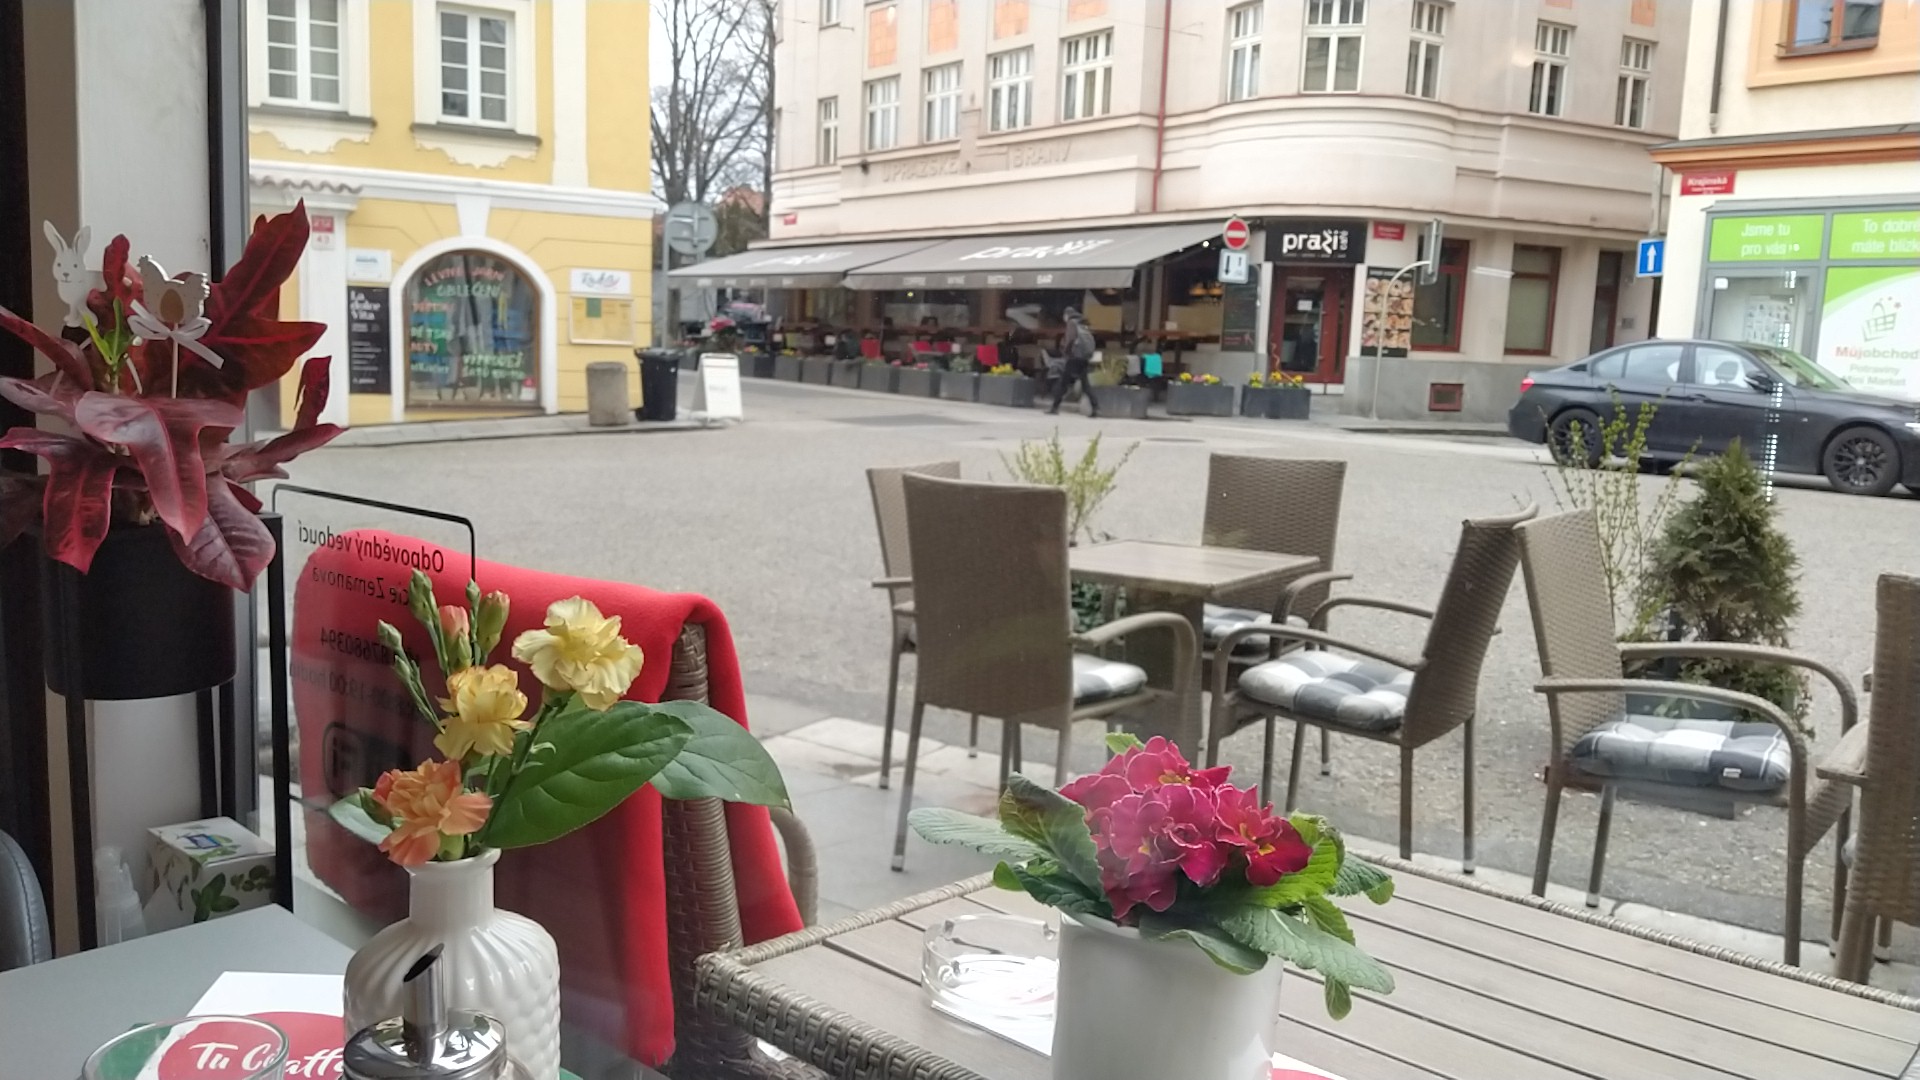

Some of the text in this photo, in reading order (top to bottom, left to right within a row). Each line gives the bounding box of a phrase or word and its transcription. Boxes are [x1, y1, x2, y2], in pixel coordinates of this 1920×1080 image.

[1741, 222, 1791, 237] Jsme tu
[1862, 218, 1879, 233] To
[1741, 243, 1762, 258] pro
[189, 1042, 239, 1070] Tu
